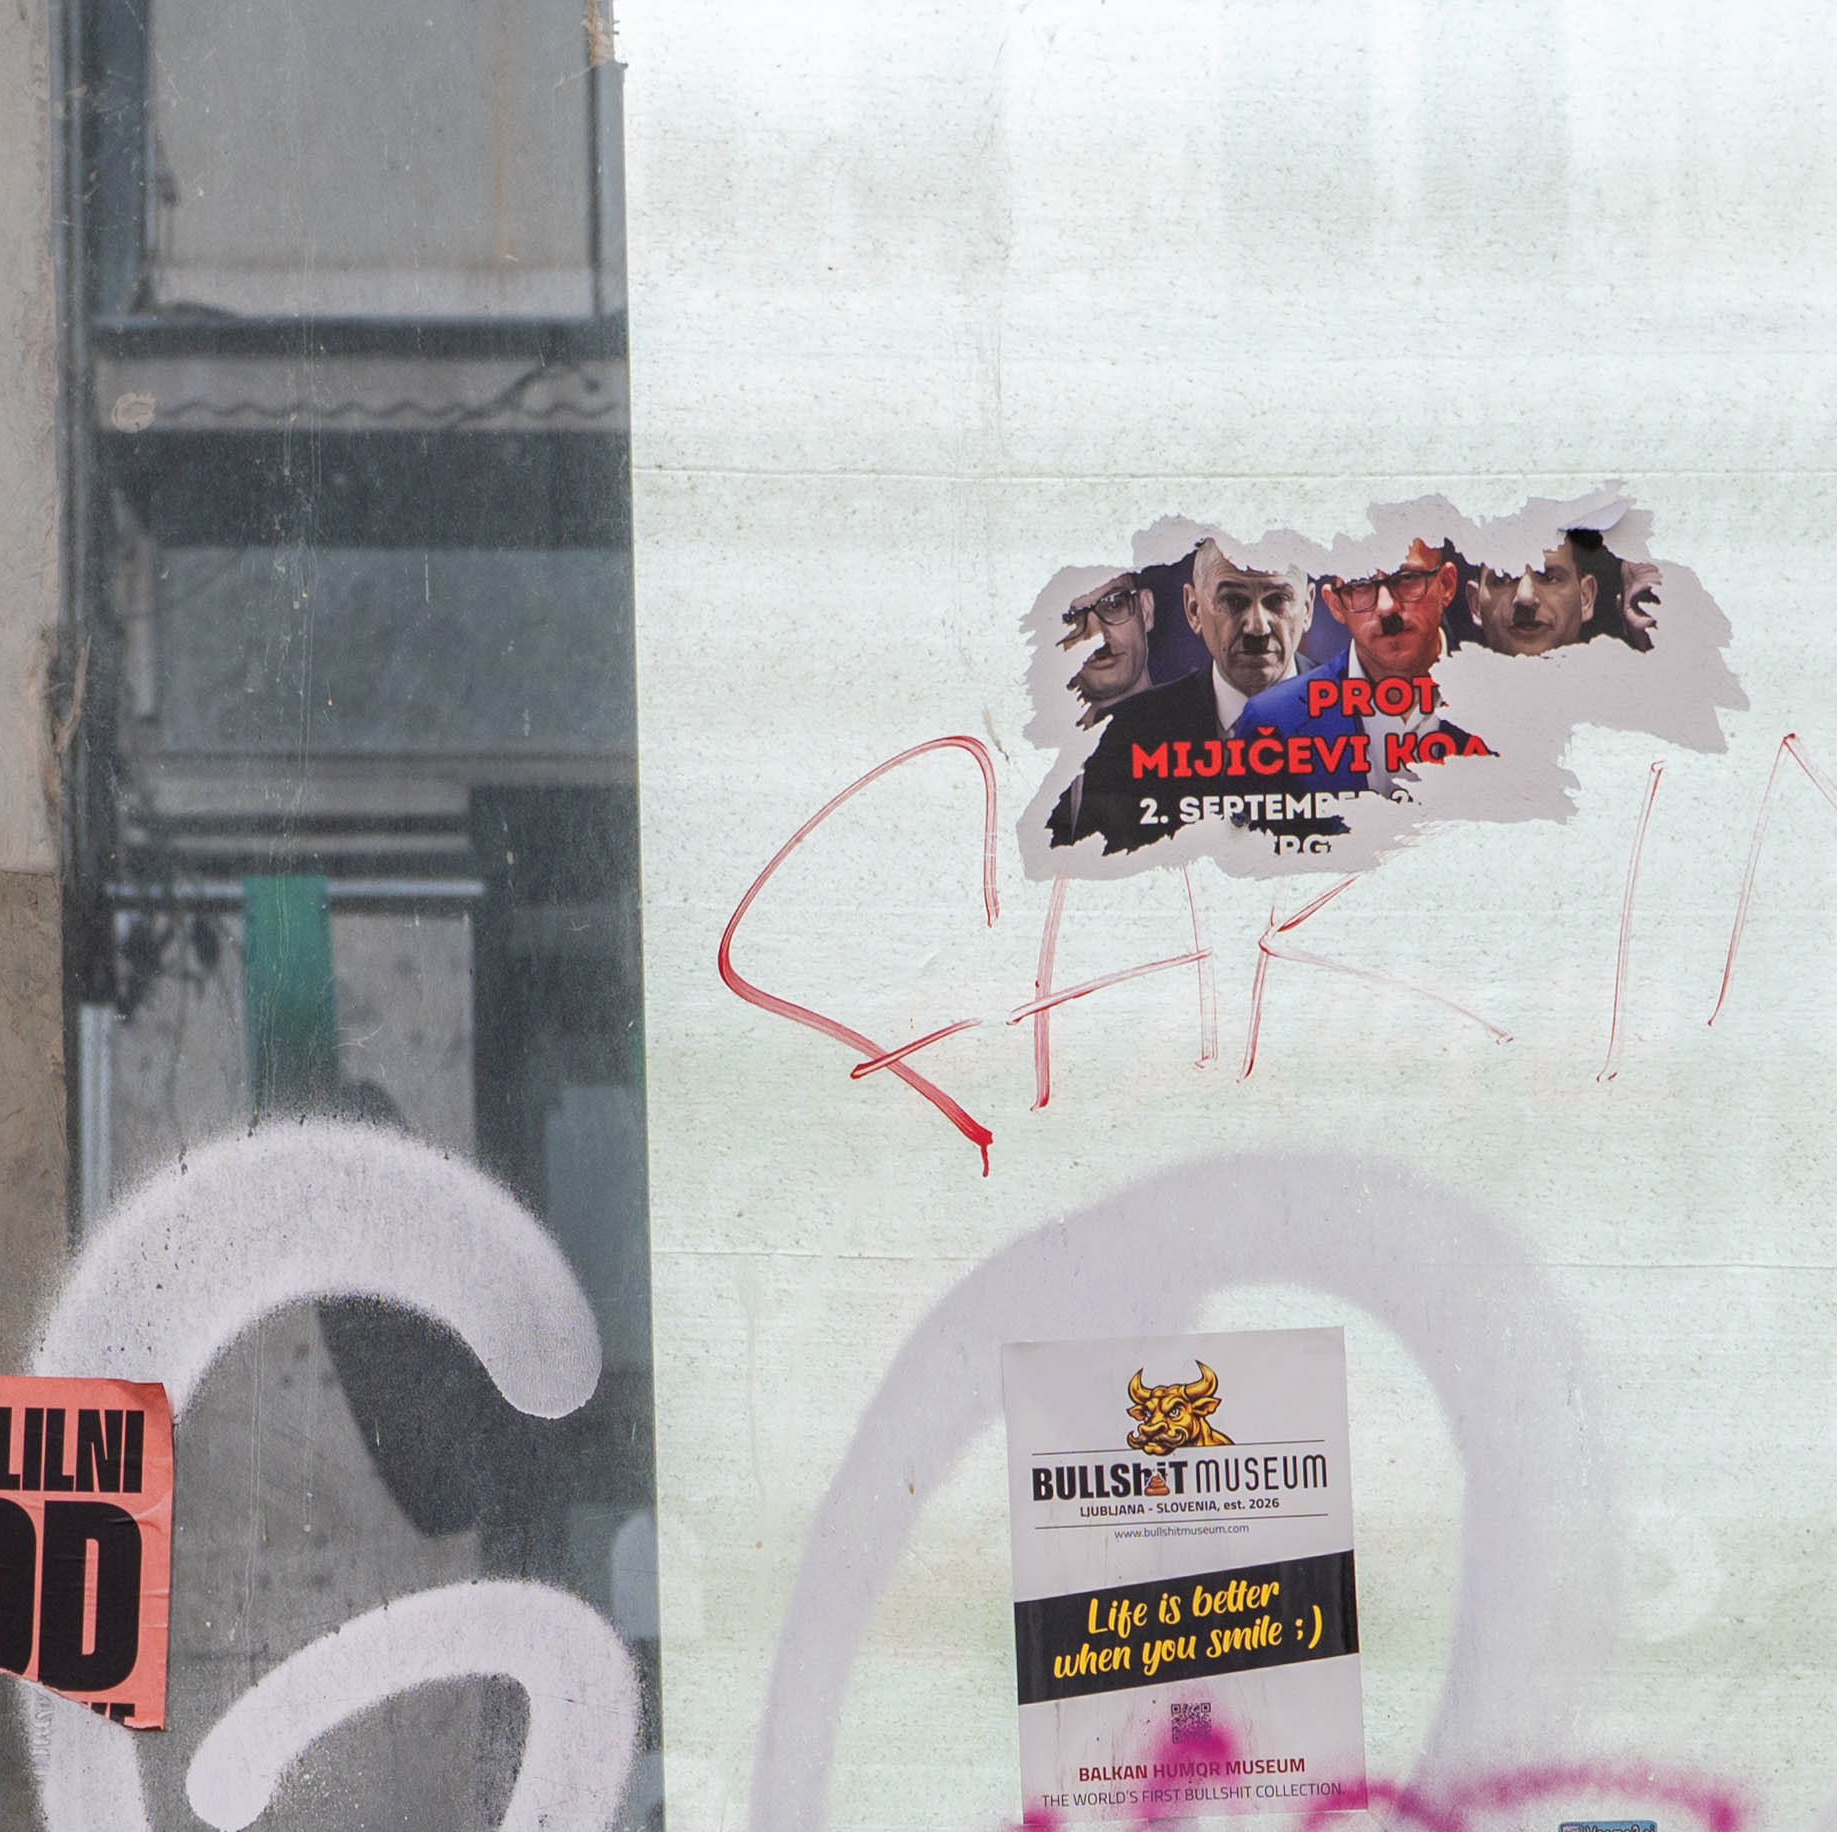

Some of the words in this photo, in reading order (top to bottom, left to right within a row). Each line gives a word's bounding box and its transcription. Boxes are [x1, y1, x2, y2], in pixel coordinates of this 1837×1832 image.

[1307, 676, 1447, 717] PROT
[1131, 726, 1370, 779] MIJIČEVI
[1139, 798, 1169, 825] 2.
[1195, 1454, 1328, 1494] MUSEUM
[1080, 1503, 1145, 1517] LJUBLJANA
[1156, 1501, 1221, 1515] SLOVENIA,
[1223, 1500, 1246, 1511] est.
[1249, 1498, 1280, 1510] 2026
[1114, 1523, 1250, 1541] www.bullshitmuseum.com
[1088, 1597, 1148, 1639] Life
[1158, 1592, 1182, 1624] is
[1192, 1579, 1280, 1617] better
[1053, 1643, 1131, 1678] when
[1142, 1635, 1197, 1677] you
[1206, 1615, 1283, 1659] smile
[1079, 1763, 1148, 1782] BALKAN
[1152, 1760, 1221, 1779] HUMOR
[1225, 1757, 1306, 1776] MUSEUM
[1042, 1793, 1070, 1809] THE
[1142, 1787, 1181, 1803] FIRST
[1184, 1785, 1252, 1801] BULLSHIT
[1255, 1782, 1346, 1799] COLLECTION.
